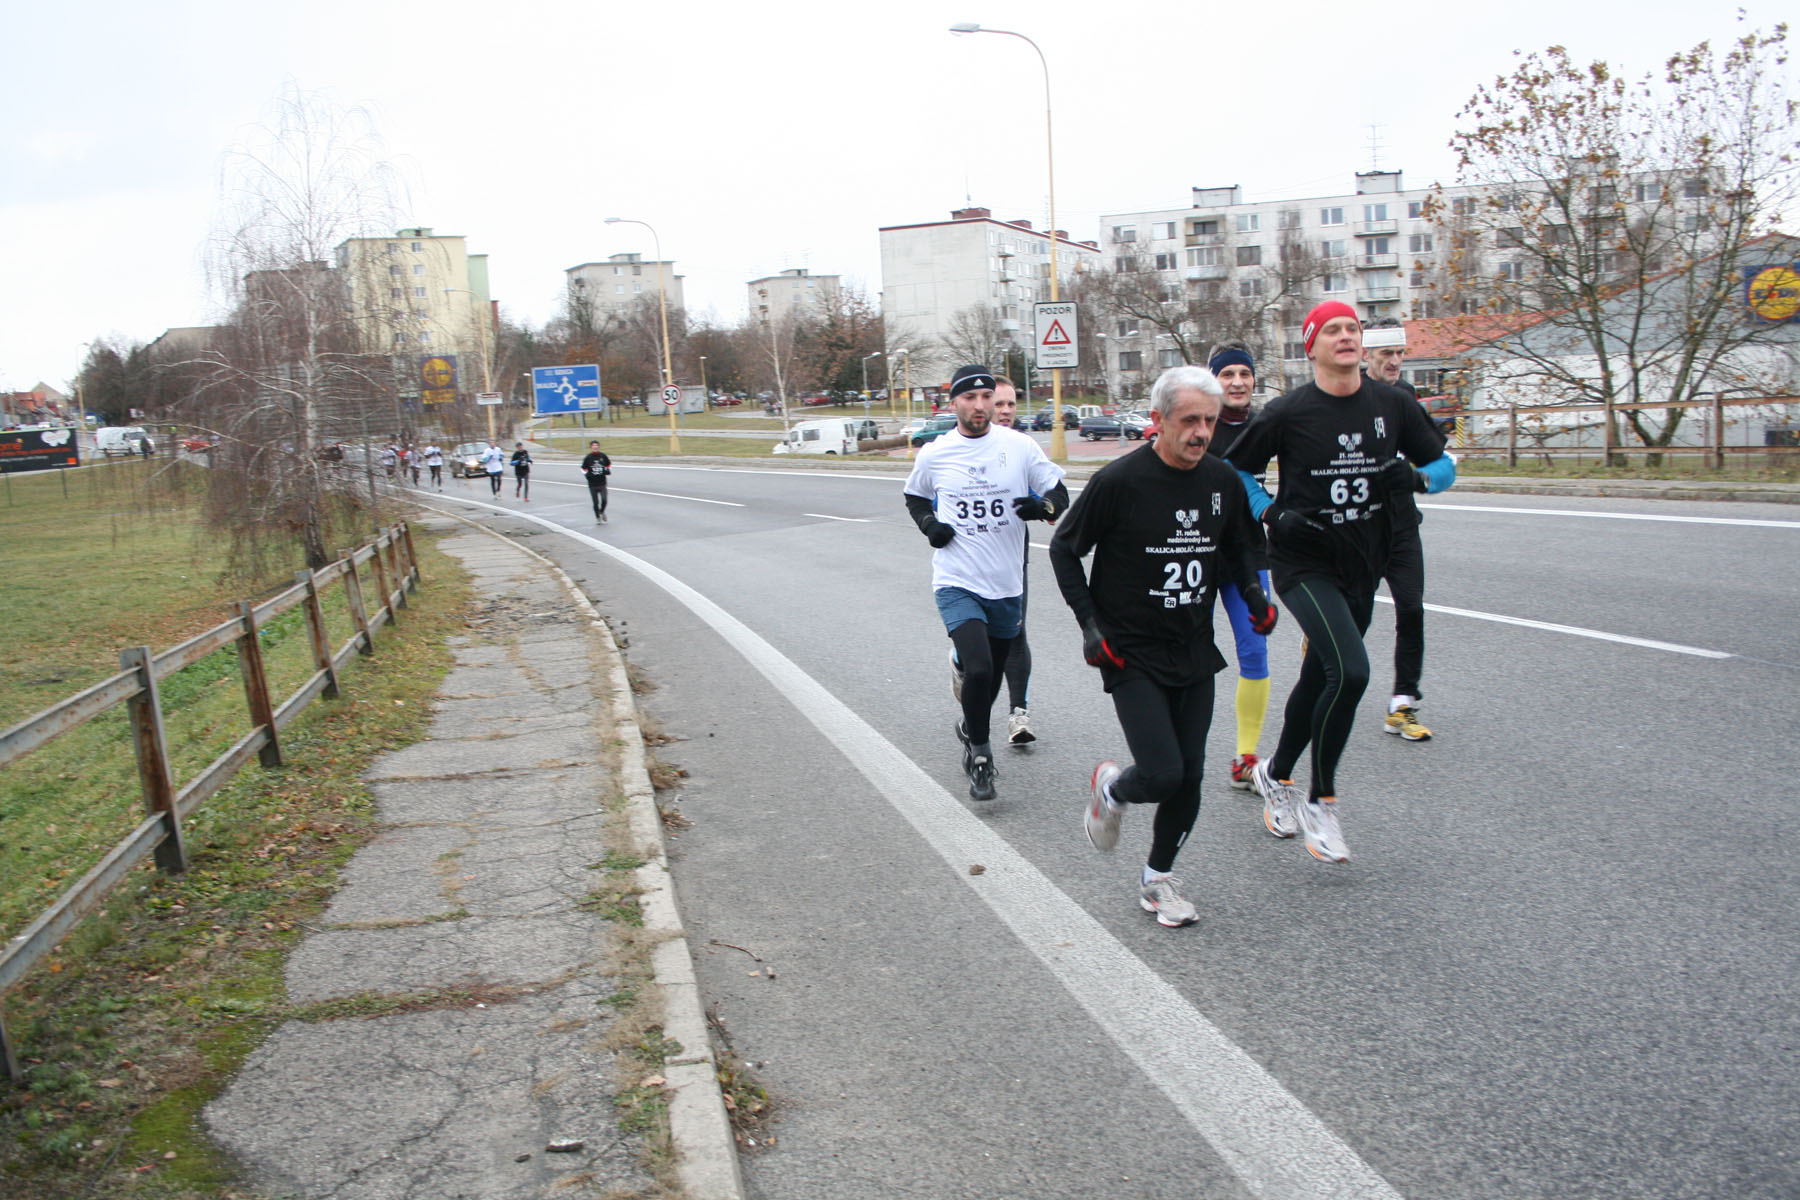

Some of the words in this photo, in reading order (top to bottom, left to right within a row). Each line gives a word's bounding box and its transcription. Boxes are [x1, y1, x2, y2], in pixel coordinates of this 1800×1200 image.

[1040, 306, 1072, 315] POZOR
[664, 389, 678, 401] 50
[1330, 477, 1369, 505] 63
[956, 498, 1004, 519] 356
[1163, 559, 1203, 590] 20
